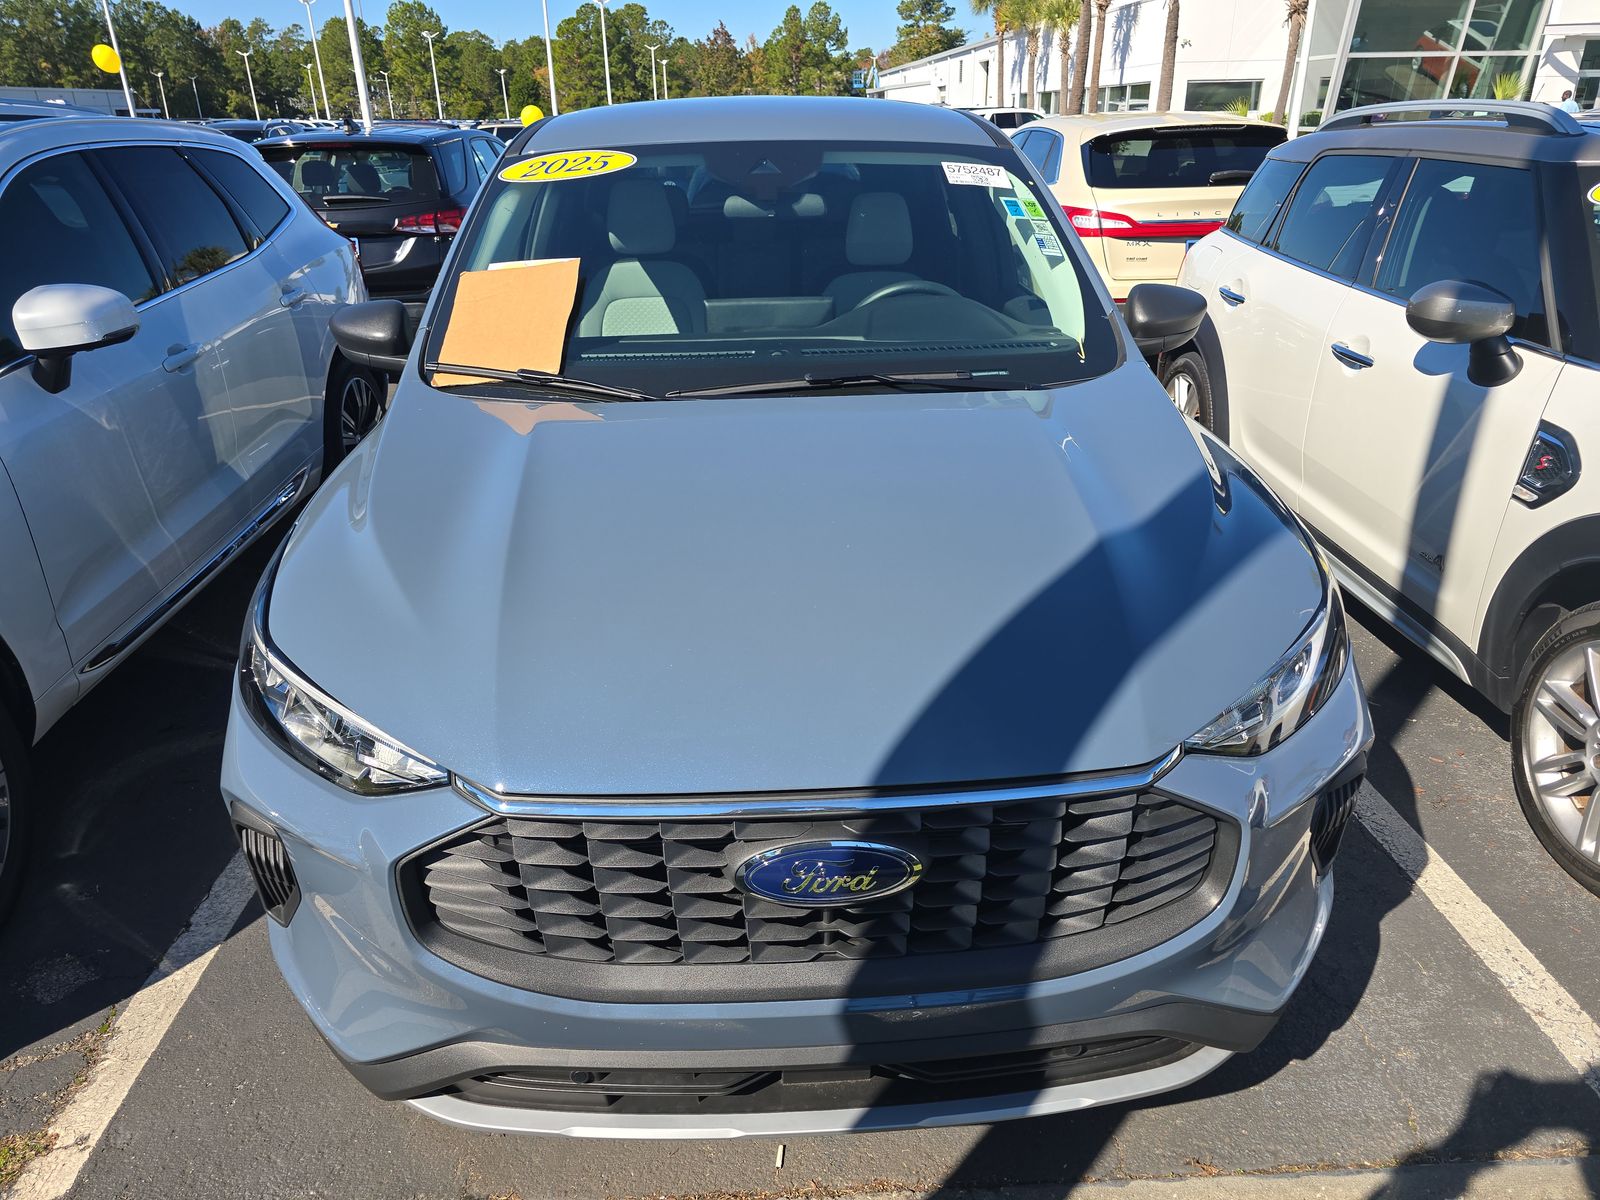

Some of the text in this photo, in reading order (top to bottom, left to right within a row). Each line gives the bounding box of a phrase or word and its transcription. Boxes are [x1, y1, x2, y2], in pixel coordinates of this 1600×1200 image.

[520, 154, 615, 178] 2025
[946, 164, 1001, 176] 5752487
[781, 858, 880, 894] Ford
